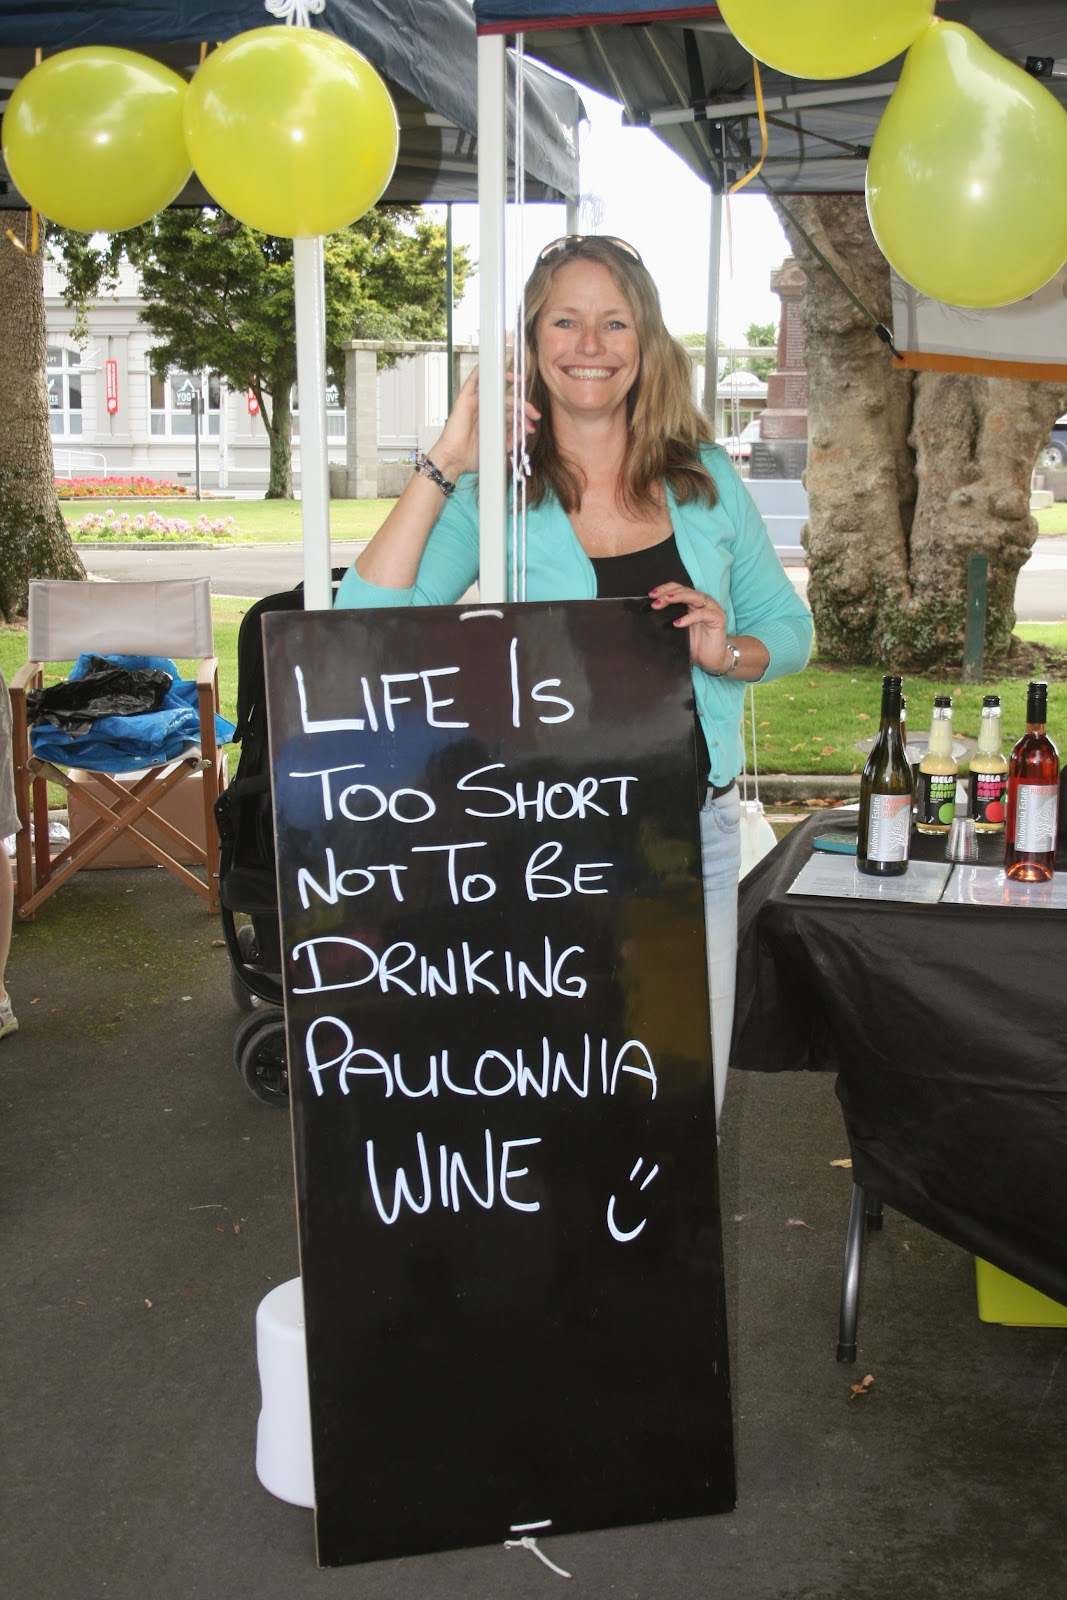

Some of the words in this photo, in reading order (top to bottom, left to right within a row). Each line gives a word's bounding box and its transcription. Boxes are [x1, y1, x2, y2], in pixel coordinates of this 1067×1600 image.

[295, 666, 470, 734] LIFE
[289, 764, 437, 824] TOO
[457, 764, 639, 823] SHORT
[298, 848, 408, 910] NOT
[525, 842, 614, 902] BE
[293, 936, 587, 1000] DRINKING
[306, 1016, 658, 1100] PAULOWNIA
[367, 1129, 542, 1225] WINE
